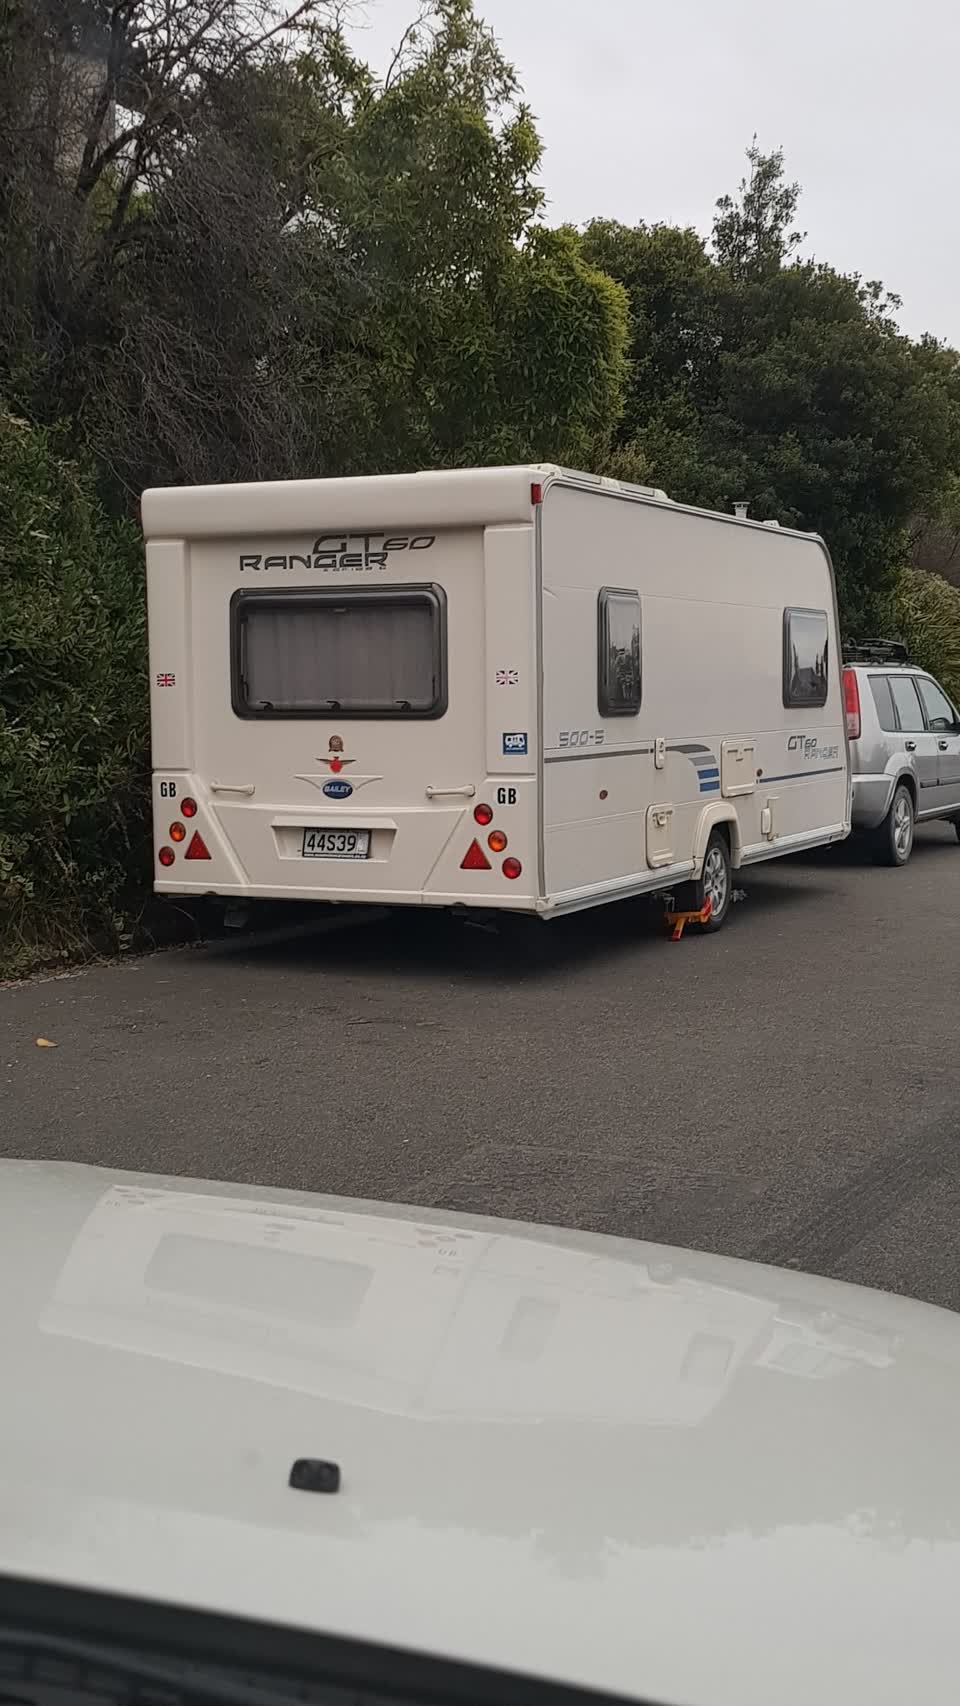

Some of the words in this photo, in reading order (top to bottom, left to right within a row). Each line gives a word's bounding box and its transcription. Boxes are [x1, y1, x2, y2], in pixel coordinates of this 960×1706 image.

[239, 552, 389, 571] RANGER
[160, 781, 177, 798] GB
[497, 787, 517, 805] GB
[306, 833, 357, 852] 44S39
